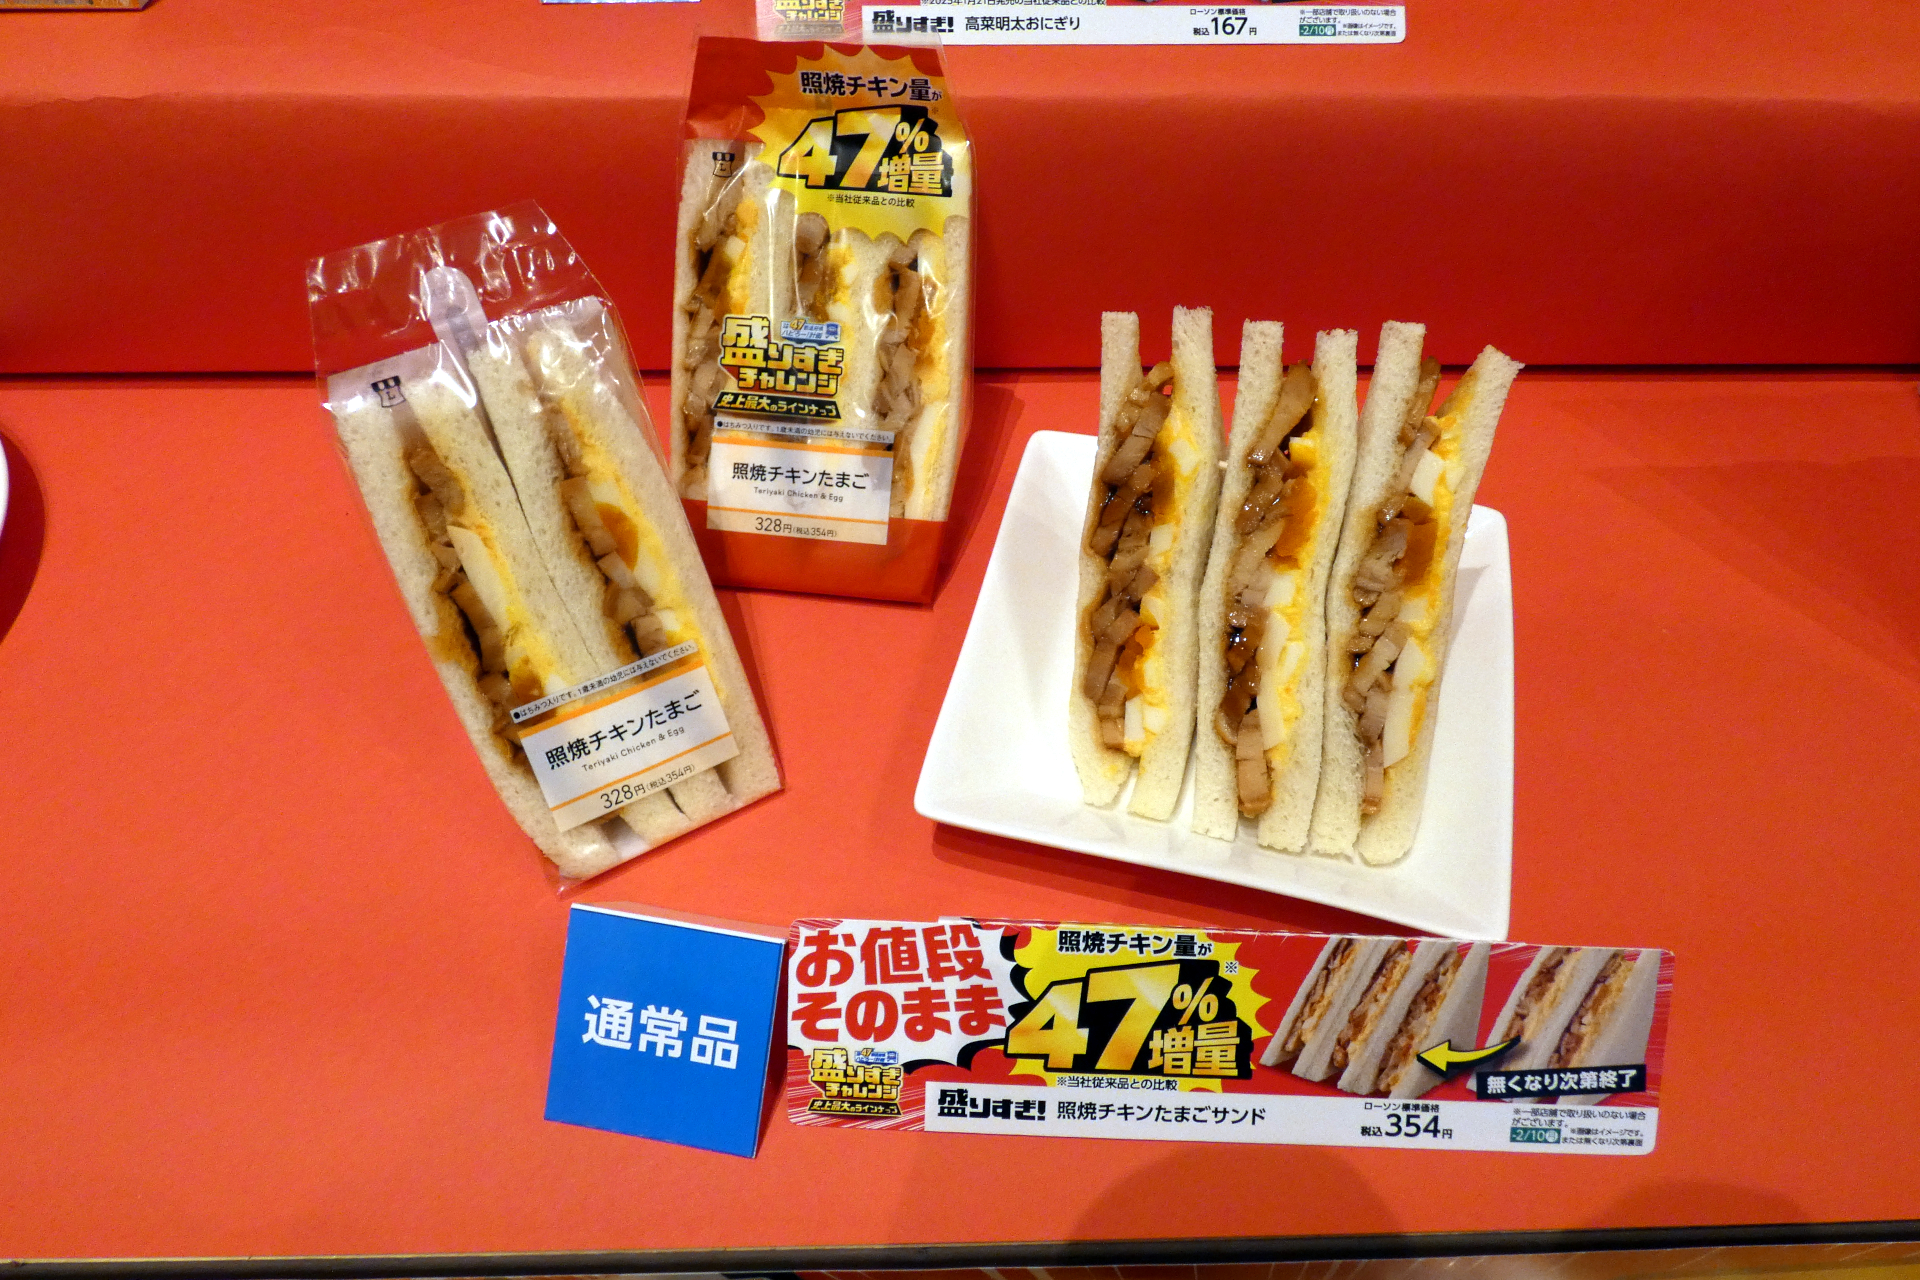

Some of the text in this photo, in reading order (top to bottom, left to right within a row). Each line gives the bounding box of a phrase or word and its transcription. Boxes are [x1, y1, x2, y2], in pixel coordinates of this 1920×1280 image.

[872, 10, 1081, 33] 盛りすぎ! 高菜明太おにぎり
[1190, 8, 1246, 16] ローソン標準価格
[800, 71, 943, 102] 照焼チキン量が
[877, 151, 945, 196] 増量
[827, 193, 915, 208] ※当社従来品との比較
[720, 316, 845, 375] 盛りすぎ
[737, 367, 838, 395] チャレンジ
[716, 394, 837, 417] 史上最大のラインナップ
[731, 462, 870, 490] 照焼チキンたまご
[753, 487, 785, 497] Teriyaki
[787, 489, 819, 500] Chicken
[828, 494, 844, 503] Egg
[545, 688, 702, 770] 照焼チキンたまご
[582, 754, 619, 773] Teriyaki
[620, 737, 657, 757] Chicken
[667, 726, 685, 740] Egg
[794, 923, 994, 989] お値段
[1058, 930, 1213, 958] 照焼チキン量が
[790, 984, 1008, 1043] そのまま
[581, 994, 740, 1070] 通常品
[1148, 1020, 1241, 1077] 増量
[812, 1047, 902, 1086] 盛りすぎ
[824, 1081, 899, 1100] チャレンジ
[1056, 1076, 1179, 1092] ※当社従来品との比較
[1486, 1069, 1638, 1095] 無くなり次第終了
[810, 1101, 899, 1115] 史上最大のラインナップ
[937, 1088, 1267, 1126] 盛りすぎ! 照焼チキンたまごサンド
[1364, 1102, 1440, 1113] ローソン標準価格
